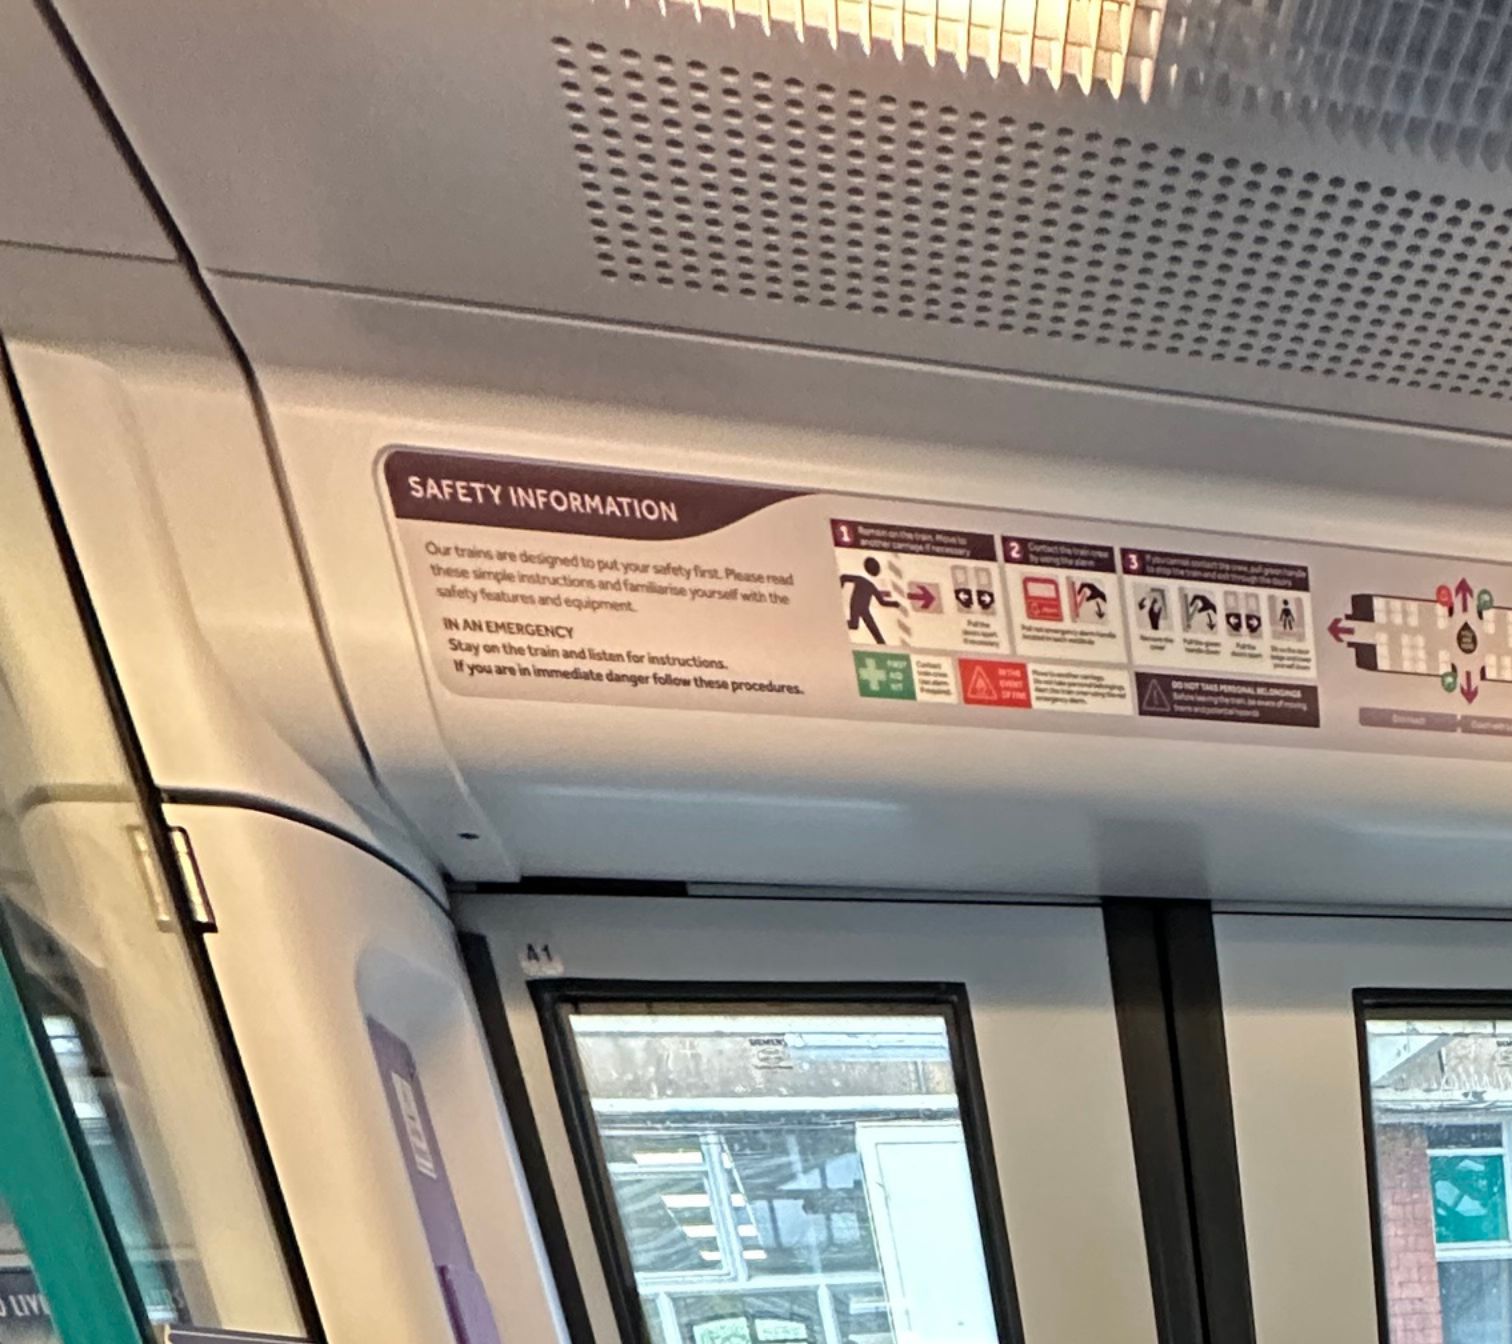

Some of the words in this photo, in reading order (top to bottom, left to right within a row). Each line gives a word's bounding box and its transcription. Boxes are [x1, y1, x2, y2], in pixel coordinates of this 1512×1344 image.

[408, 475, 501, 505] SAFETY
[509, 486, 679, 522] INFORMATION
[840, 525, 851, 542] 1
[1009, 541, 1021, 558] 2
[1127, 553, 1139, 570] 3
[425, 541, 451, 556] Our
[454, 544, 494, 560] trains
[496, 551, 518, 562] are
[519, 550, 579, 569] designed
[581, 556, 594, 570] to
[597, 559, 620, 573] put
[621, 562, 650, 575] your
[652, 562, 691, 580] safety
[725, 567, 765, 583] Please
[766, 574, 795, 586] read
[430, 563, 470, 579] these
[472, 568, 516, 584] simple
[518, 572, 596, 590] instructions
[597, 579, 622, 591] and
[623, 580, 687, 597] familiarise
[689, 587, 739, 601] yourself
[740, 591, 768, 603] with
[769, 592, 791, 605] the
[436, 586, 478, 603] safety
[480, 588, 536, 605] features
[538, 594, 562, 606] and
[564, 597, 637, 613] equipment.
[443, 617, 459, 631] IN
[462, 619, 483, 632] AN
[485, 621, 574, 639] EMERGENCY
[448, 638, 480, 656] Stay
[483, 644, 500, 654] on
[502, 643, 526, 656] the
[527, 644, 560, 658] train
[562, 648, 587, 660] and
[588, 649, 625, 662] listen
[626, 651, 645, 664] for
[647, 652, 728, 670] instructions.
[453, 659, 464, 672] If
[467, 663, 493, 677] you
[495, 665, 517, 676] are
[518, 663, 531, 676] in
[533, 664, 604, 682] immediate
[606, 670, 651, 687] danger
[653, 672, 691, 687] follow
[693, 676, 729, 690] these
[731, 680, 805, 695] procedures.
[526, 943, 553, 962] A1
